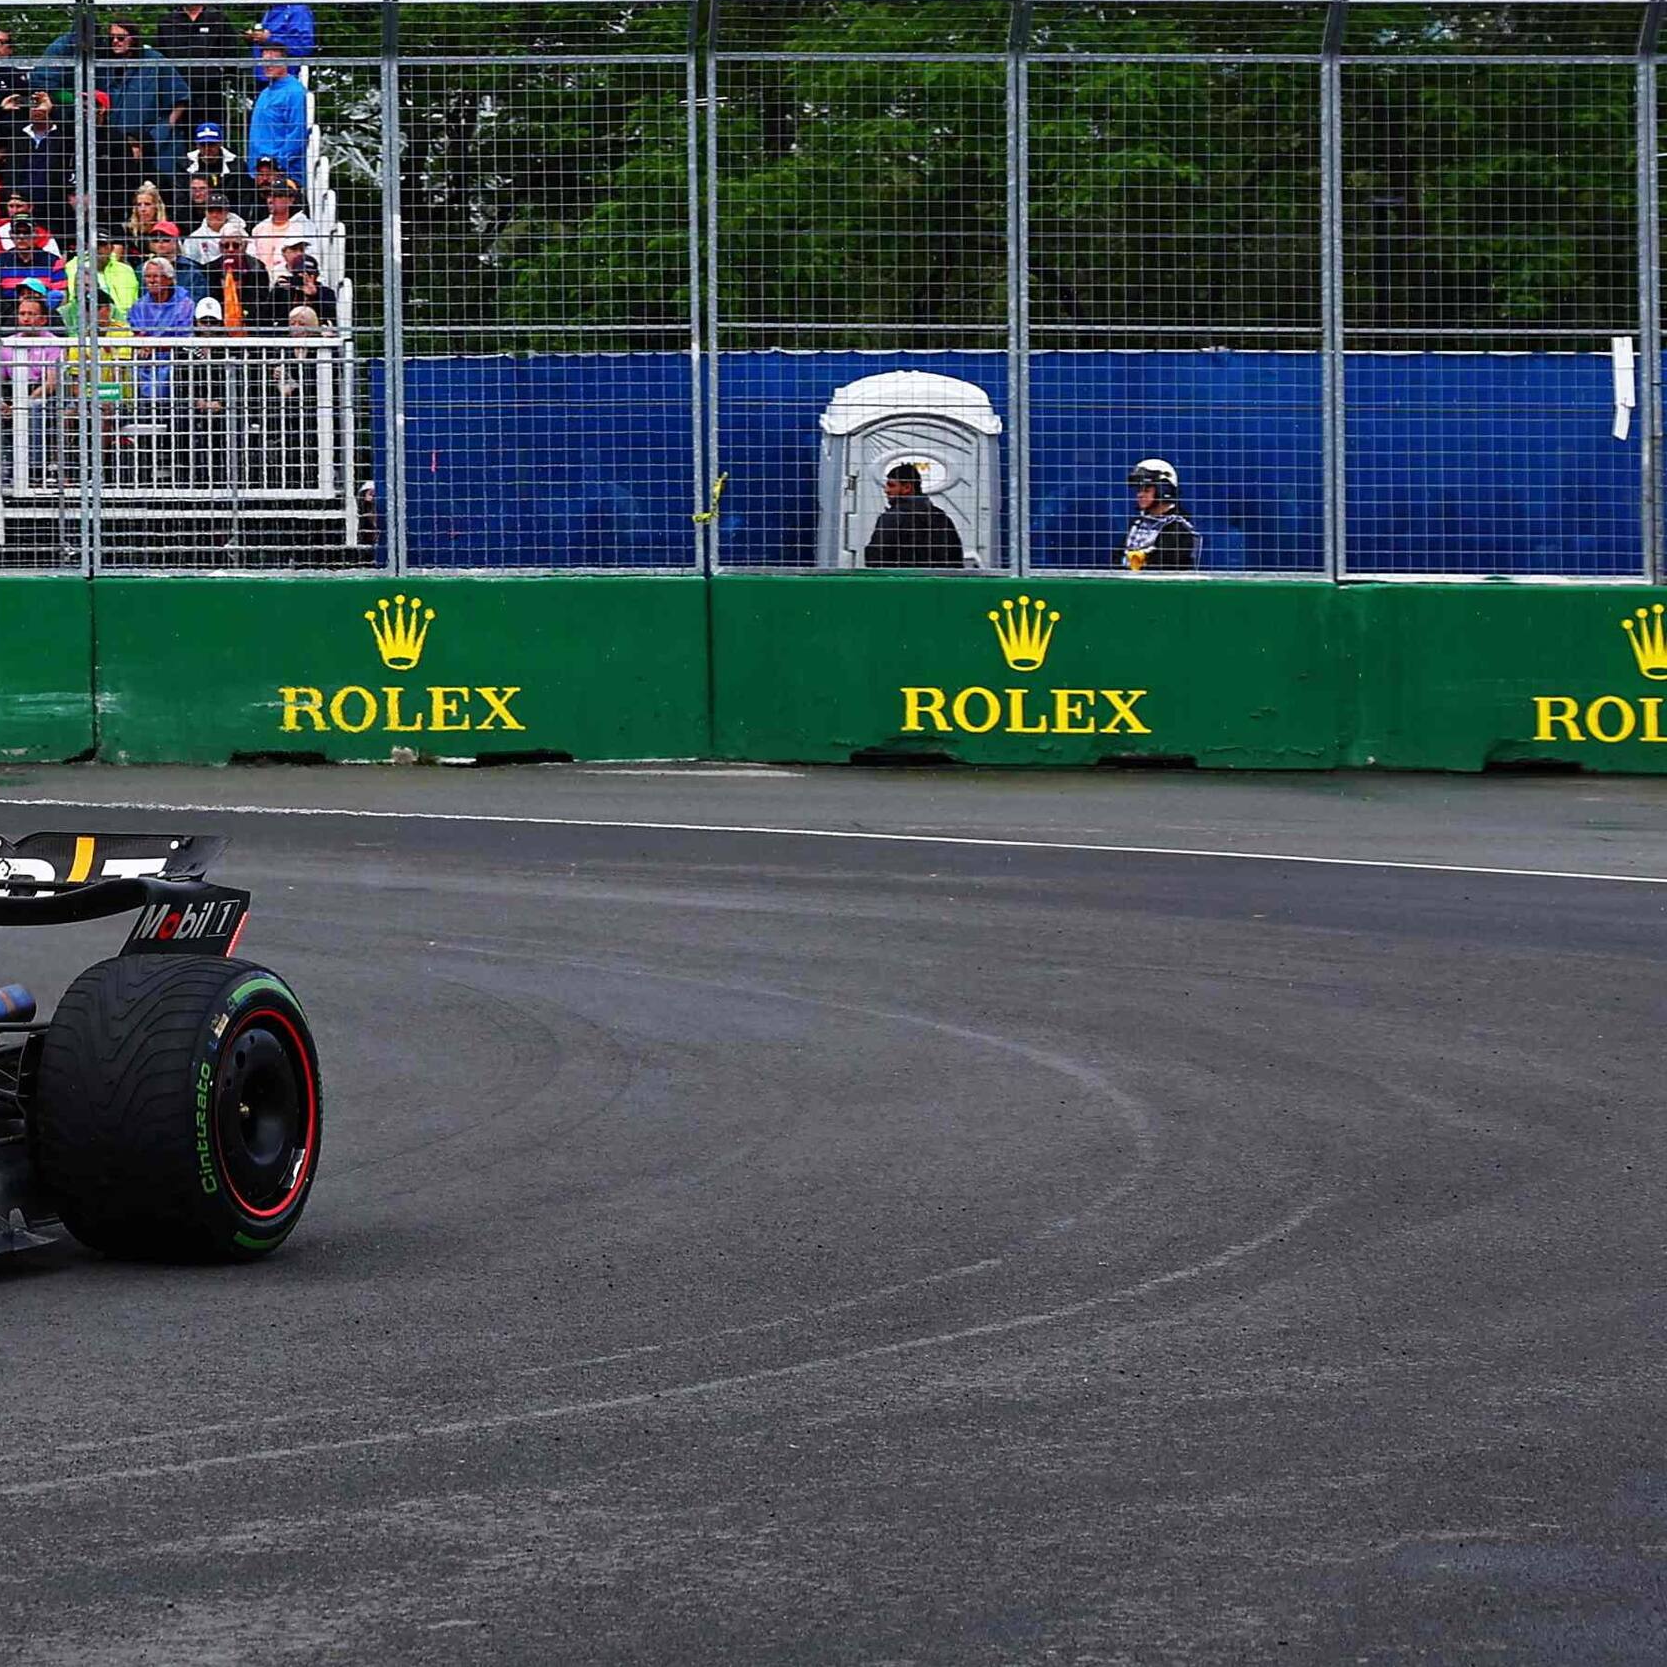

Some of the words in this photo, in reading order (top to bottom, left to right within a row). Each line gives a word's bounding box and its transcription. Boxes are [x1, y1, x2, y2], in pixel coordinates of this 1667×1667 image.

[278, 686, 526, 733] ROLEX
[900, 686, 1152, 734] ROLEX
[1532, 695, 1667, 744] ROL
[133, 901, 216, 940] Mobil
[216, 902, 233, 934] 1
[196, 1061, 218, 1194] Cinturato
